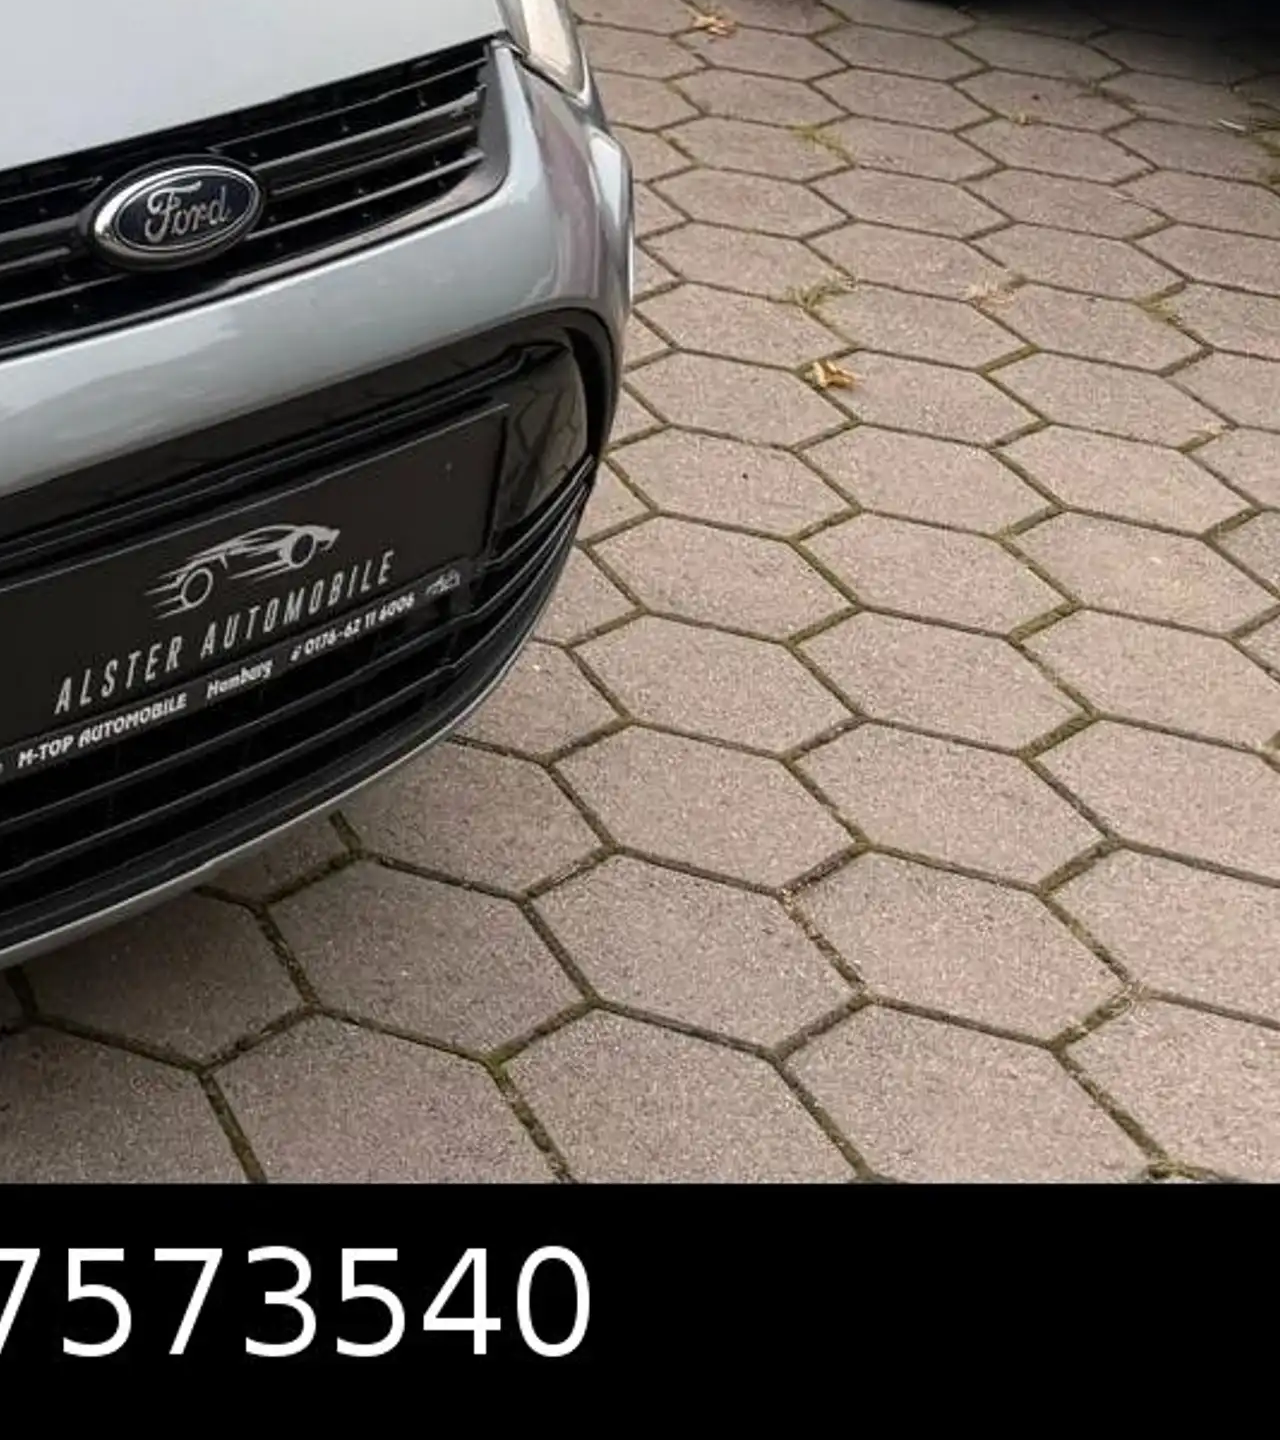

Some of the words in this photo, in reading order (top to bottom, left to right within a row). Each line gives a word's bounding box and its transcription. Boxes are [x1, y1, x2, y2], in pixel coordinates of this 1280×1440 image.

[144, 180, 231, 243] Ford
[54, 635, 184, 716] ALSTER
[200, 549, 395, 660] AUTOMOBILE
[17, 735, 75, 769] M-TOP
[78, 692, 188, 748] AUTOMOBILE
[206, 658, 273, 700] Hamburg
